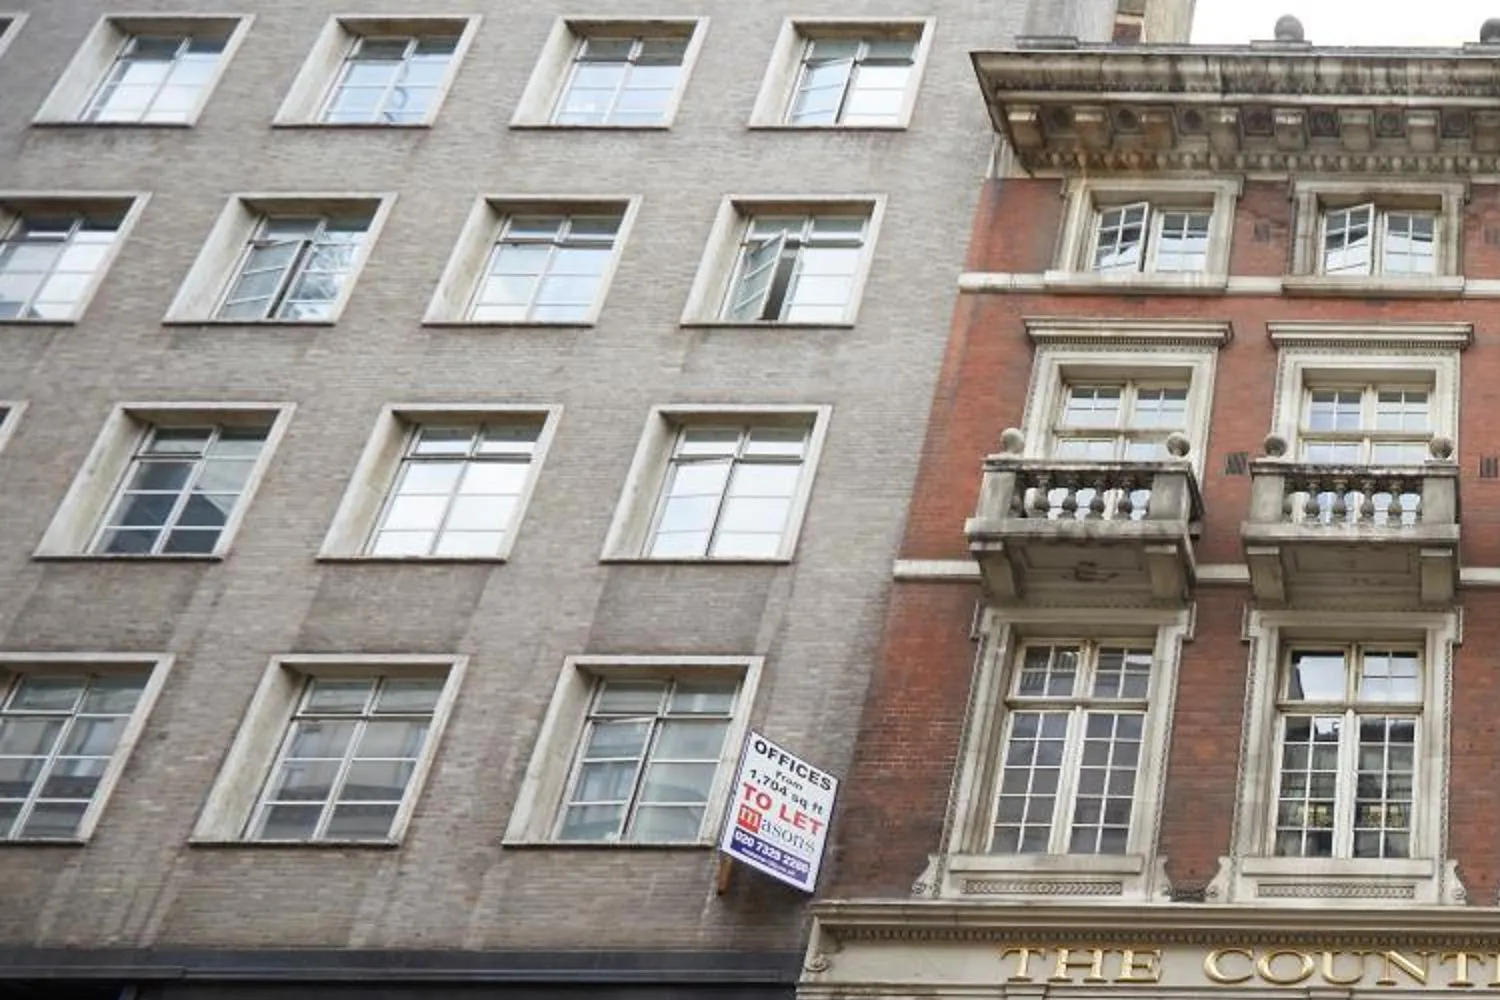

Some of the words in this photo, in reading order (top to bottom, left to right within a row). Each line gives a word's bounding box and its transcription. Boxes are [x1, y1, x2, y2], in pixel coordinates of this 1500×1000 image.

[754, 739, 831, 791] OFFICES
[743, 783, 773, 811] TO
[779, 804, 825, 836] LET
[1001, 946, 1164, 984] THE
